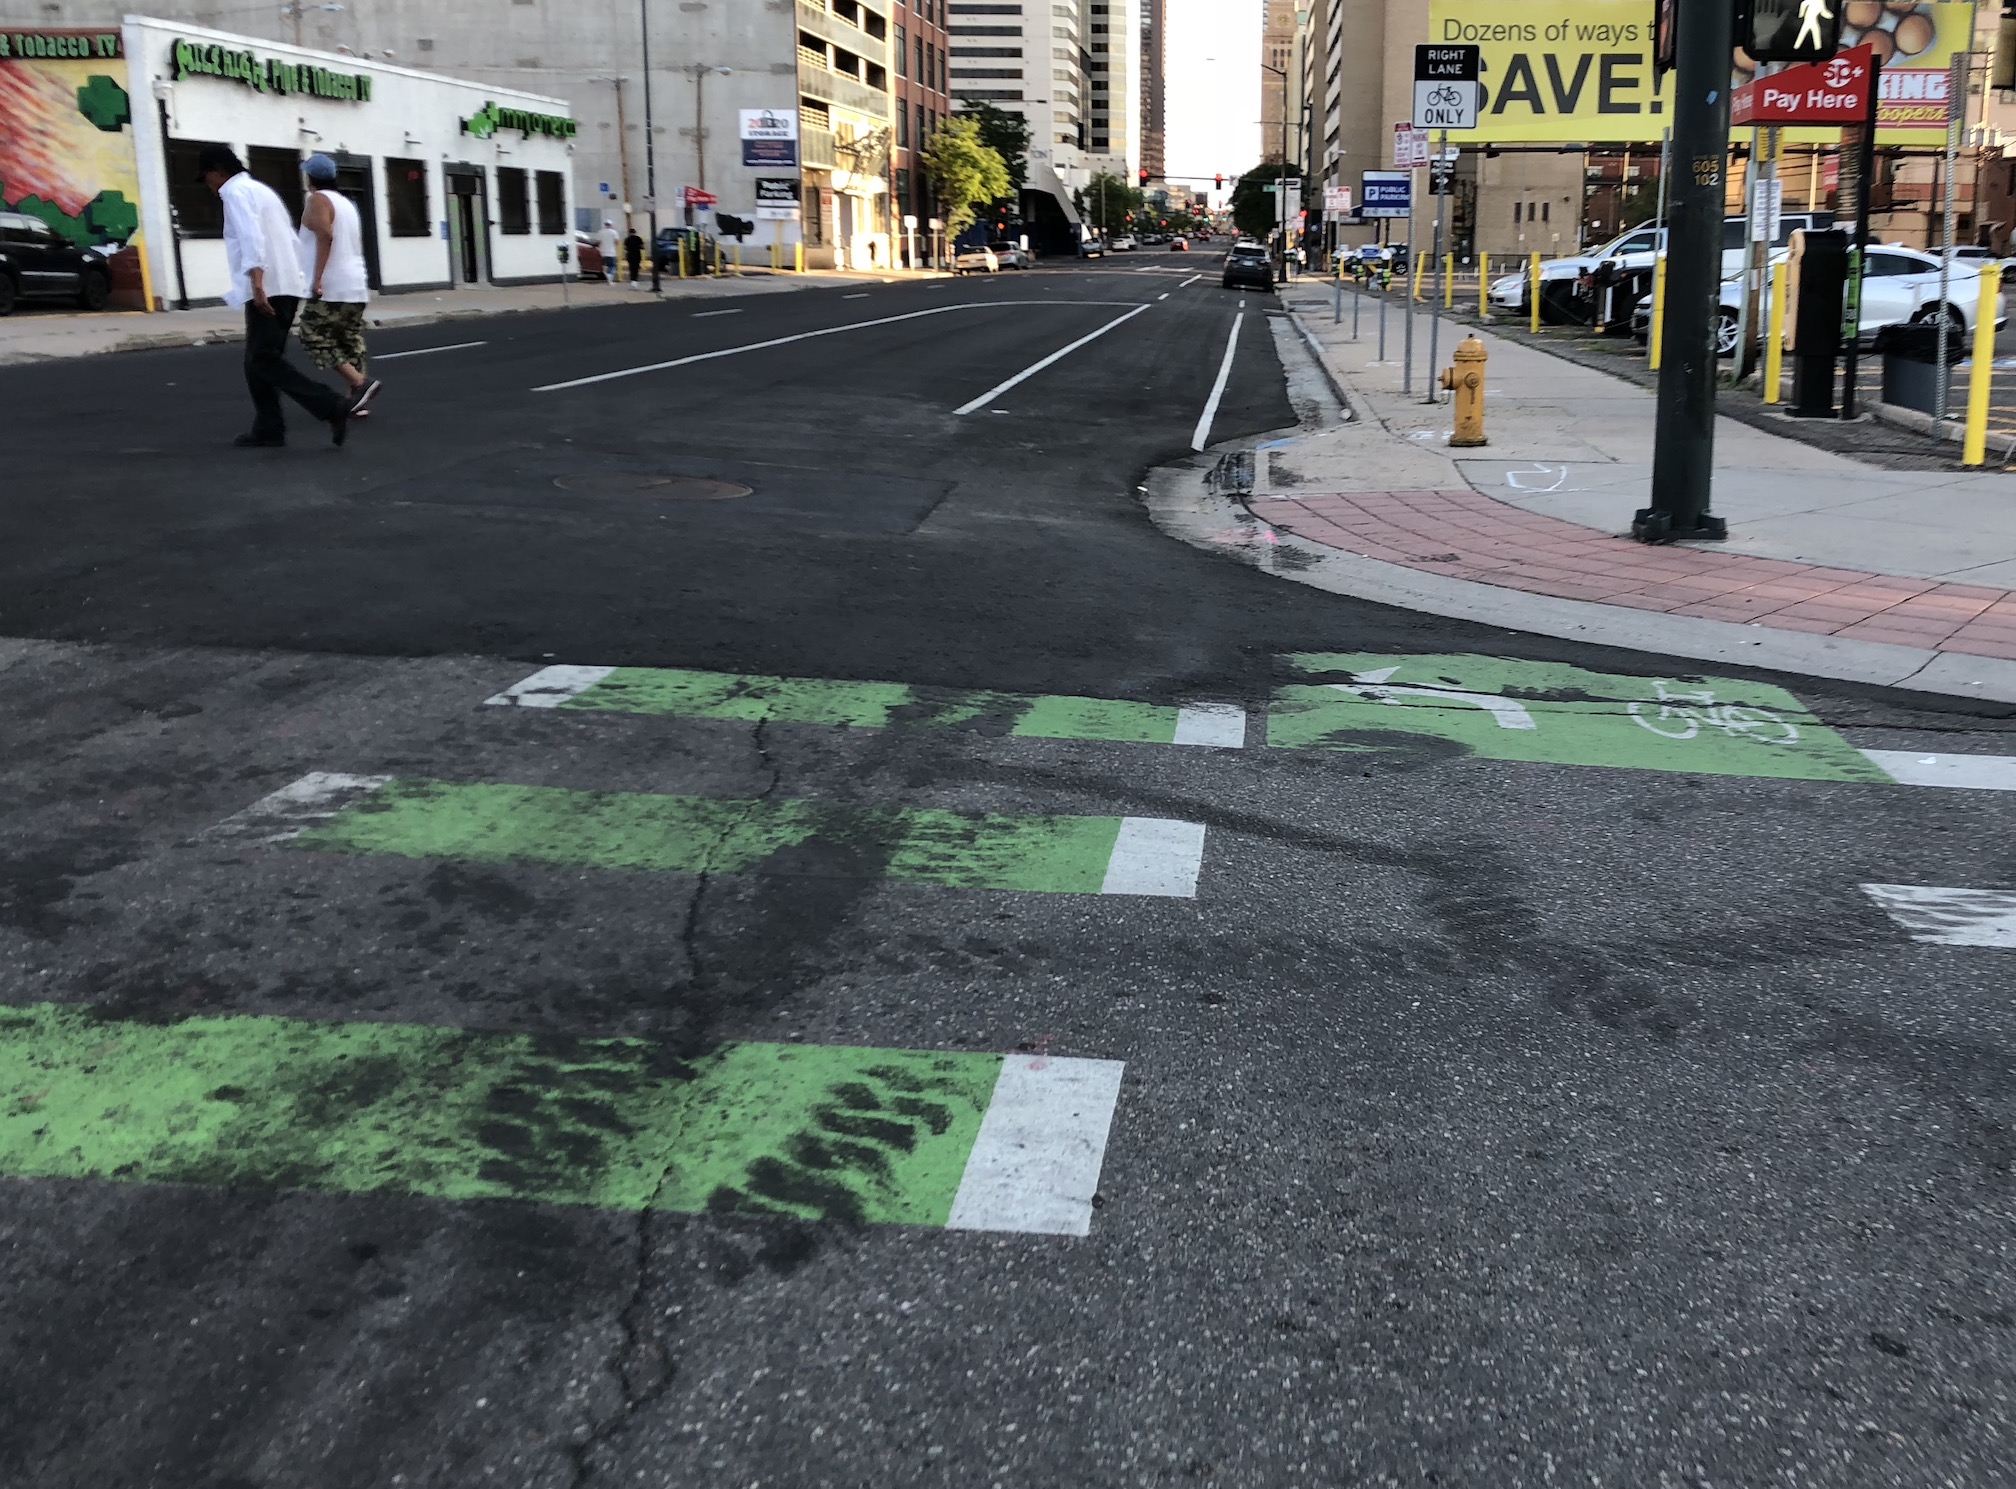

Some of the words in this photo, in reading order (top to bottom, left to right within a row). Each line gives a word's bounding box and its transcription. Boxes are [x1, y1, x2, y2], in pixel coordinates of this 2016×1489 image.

[1443, 19, 1536, 42] Dozens
[1545, 19, 1570, 42] of
[1576, 23, 1638, 46] ways
[14, 33, 90, 58] Tobacco
[1428, 50, 1466, 60] RIGHT
[1428, 64, 1463, 74] LANE
[1478, 53, 1664, 115] AVE!
[1763, 88, 1801, 112] Pay
[1806, 89, 1858, 109] Here
[1425, 108, 1464, 123] ONLY
[1877, 102, 1947, 126] oopers
[1692, 160, 1719, 173] 605
[1694, 173, 1719, 186] 102
